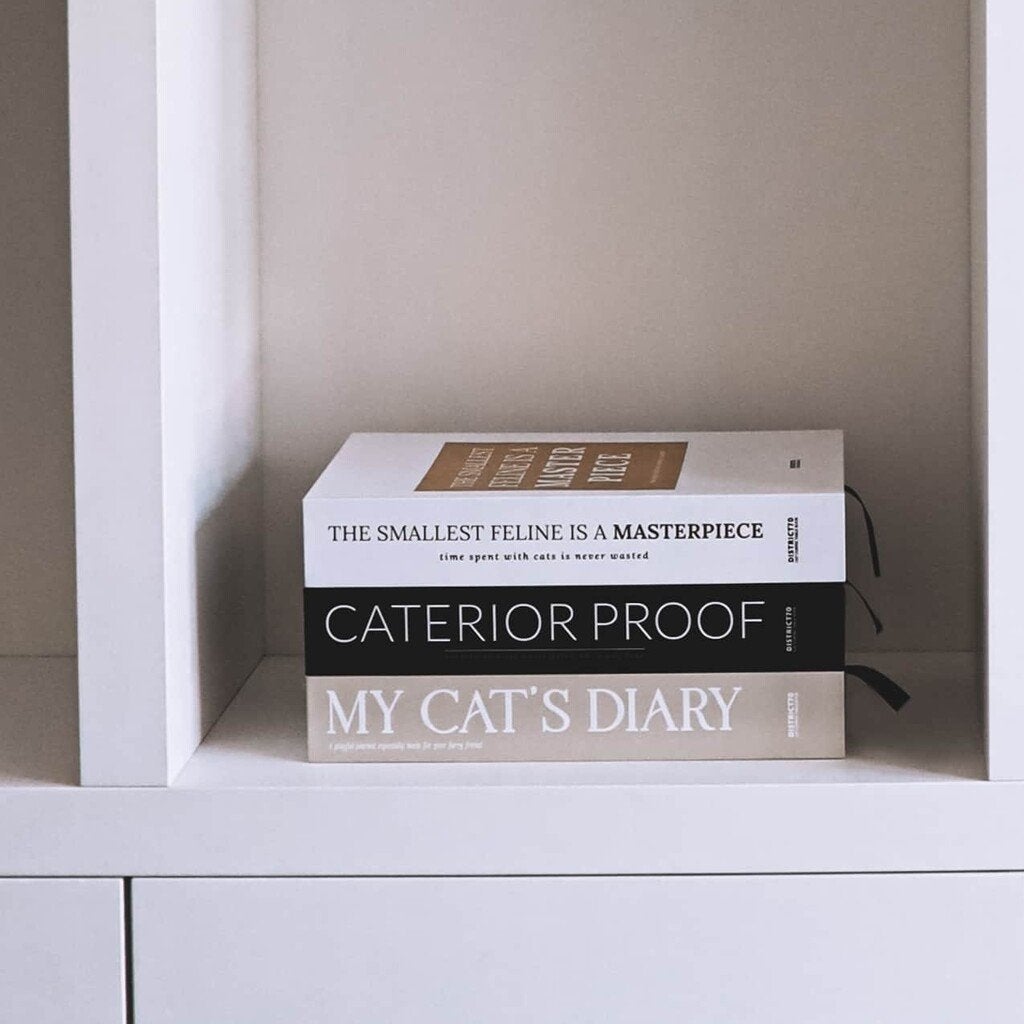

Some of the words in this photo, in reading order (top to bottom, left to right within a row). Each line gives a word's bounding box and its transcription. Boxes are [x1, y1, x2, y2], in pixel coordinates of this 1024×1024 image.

[502, 454, 535, 463] IS
[534, 447, 587, 488] MASTER
[587, 453, 632, 483] PIECE
[488, 463, 531, 488] FELINE
[328, 525, 372, 542] THE
[377, 524, 485, 542] SMALLEST
[490, 524, 563, 541] FELINE
[569, 524, 588, 541] IS
[593, 524, 608, 541] A
[612, 522, 764, 540] MASTERPIECE
[439, 552, 465, 562] time
[469, 552, 500, 564] spent
[503, 552, 529, 562] with
[533, 552, 557, 562] cats
[561, 551, 571, 561] is
[575, 552, 605, 561] never
[610, 551, 650, 561] wasted
[325, 602, 578, 644] CATERIOR
[593, 600, 766, 642] PROOF
[326, 689, 405, 735] MY
[420, 685, 571, 734] CAT'S
[586, 686, 743, 732] DIARY
